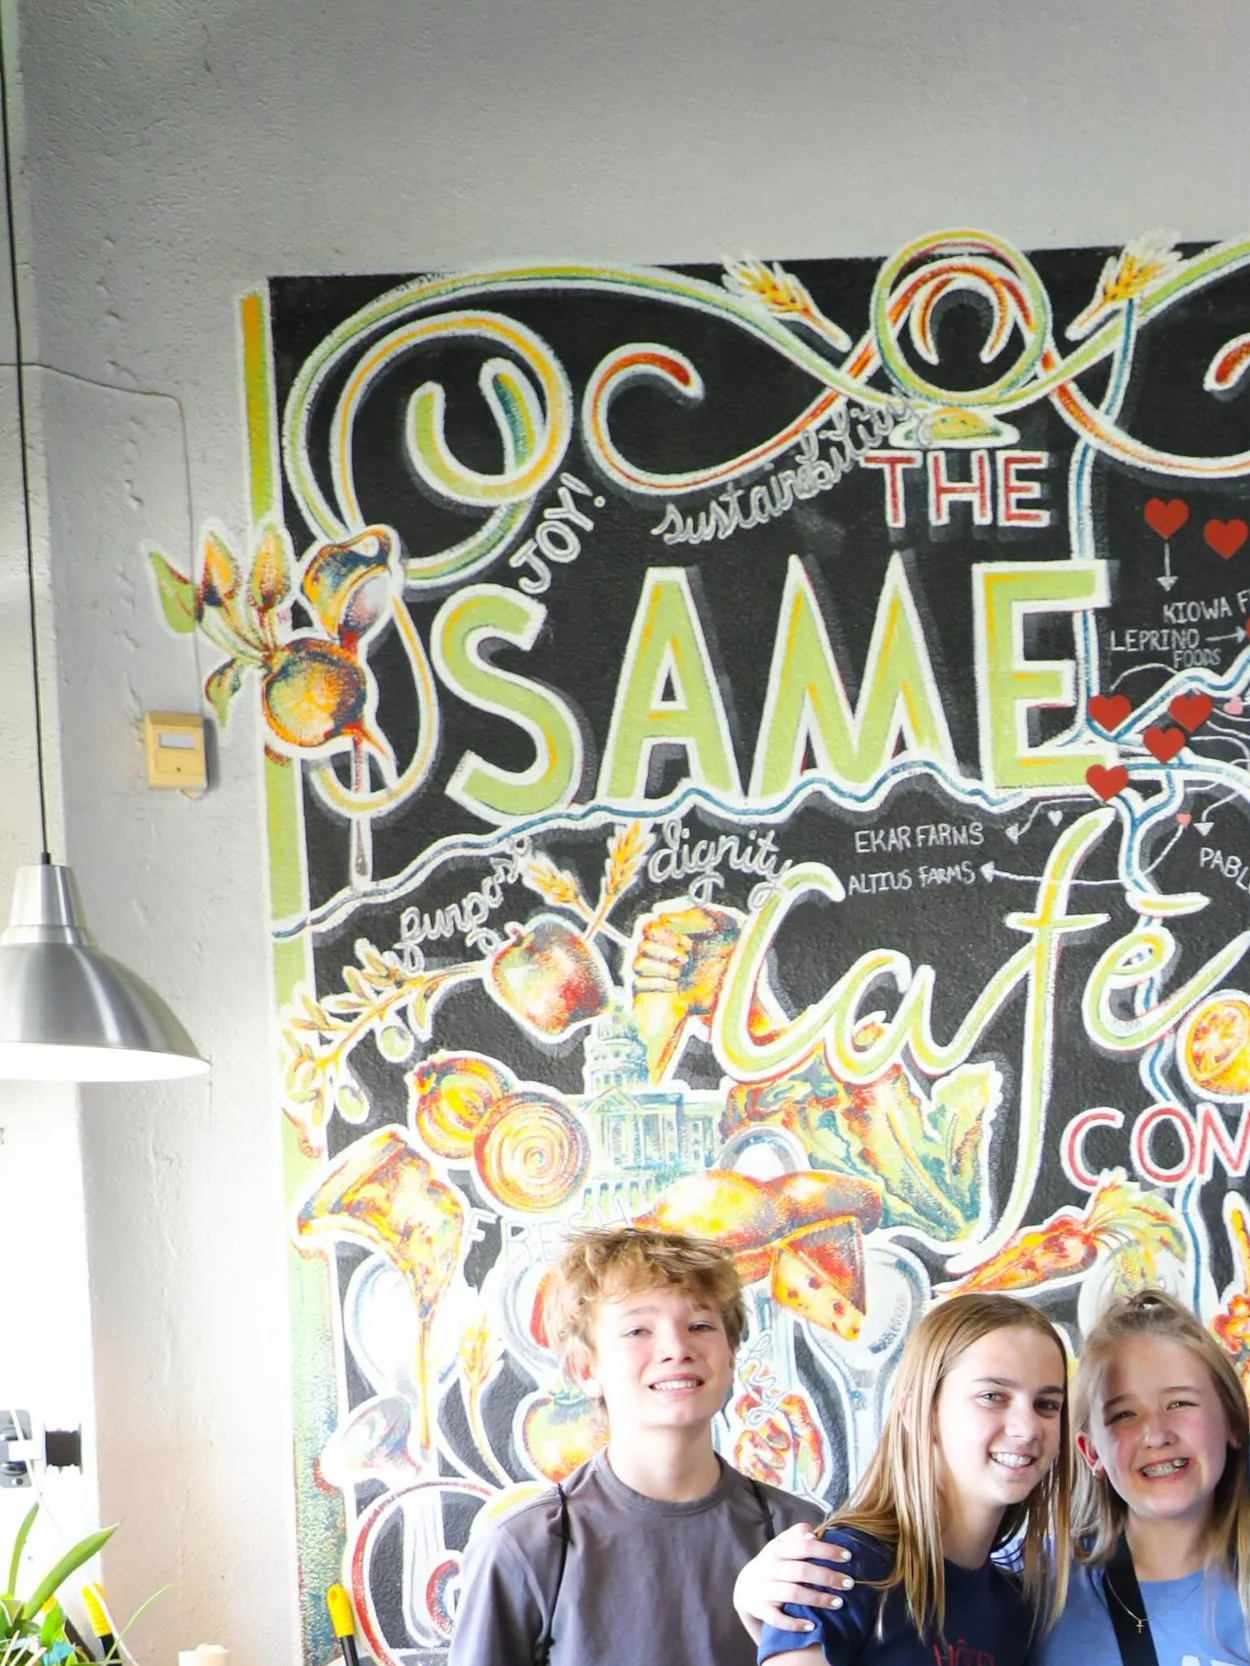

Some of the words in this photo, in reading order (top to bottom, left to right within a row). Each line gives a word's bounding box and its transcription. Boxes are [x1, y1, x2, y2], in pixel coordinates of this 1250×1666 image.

[859, 446, 1050, 528] THE
[509, 472, 600, 593] JOY!
[1163, 596, 1232, 624] KIOWA
[1110, 628, 1200, 652] LEPRINO
[1173, 648, 1222, 669] FOODS
[430, 553, 1112, 825] SAME
[854, 825, 911, 853] EKAR
[915, 822, 985, 848] FARMS
[648, 818, 794, 910] dignity
[849, 868, 913, 896] ALTIUS
[919, 861, 976, 889] FARMS
